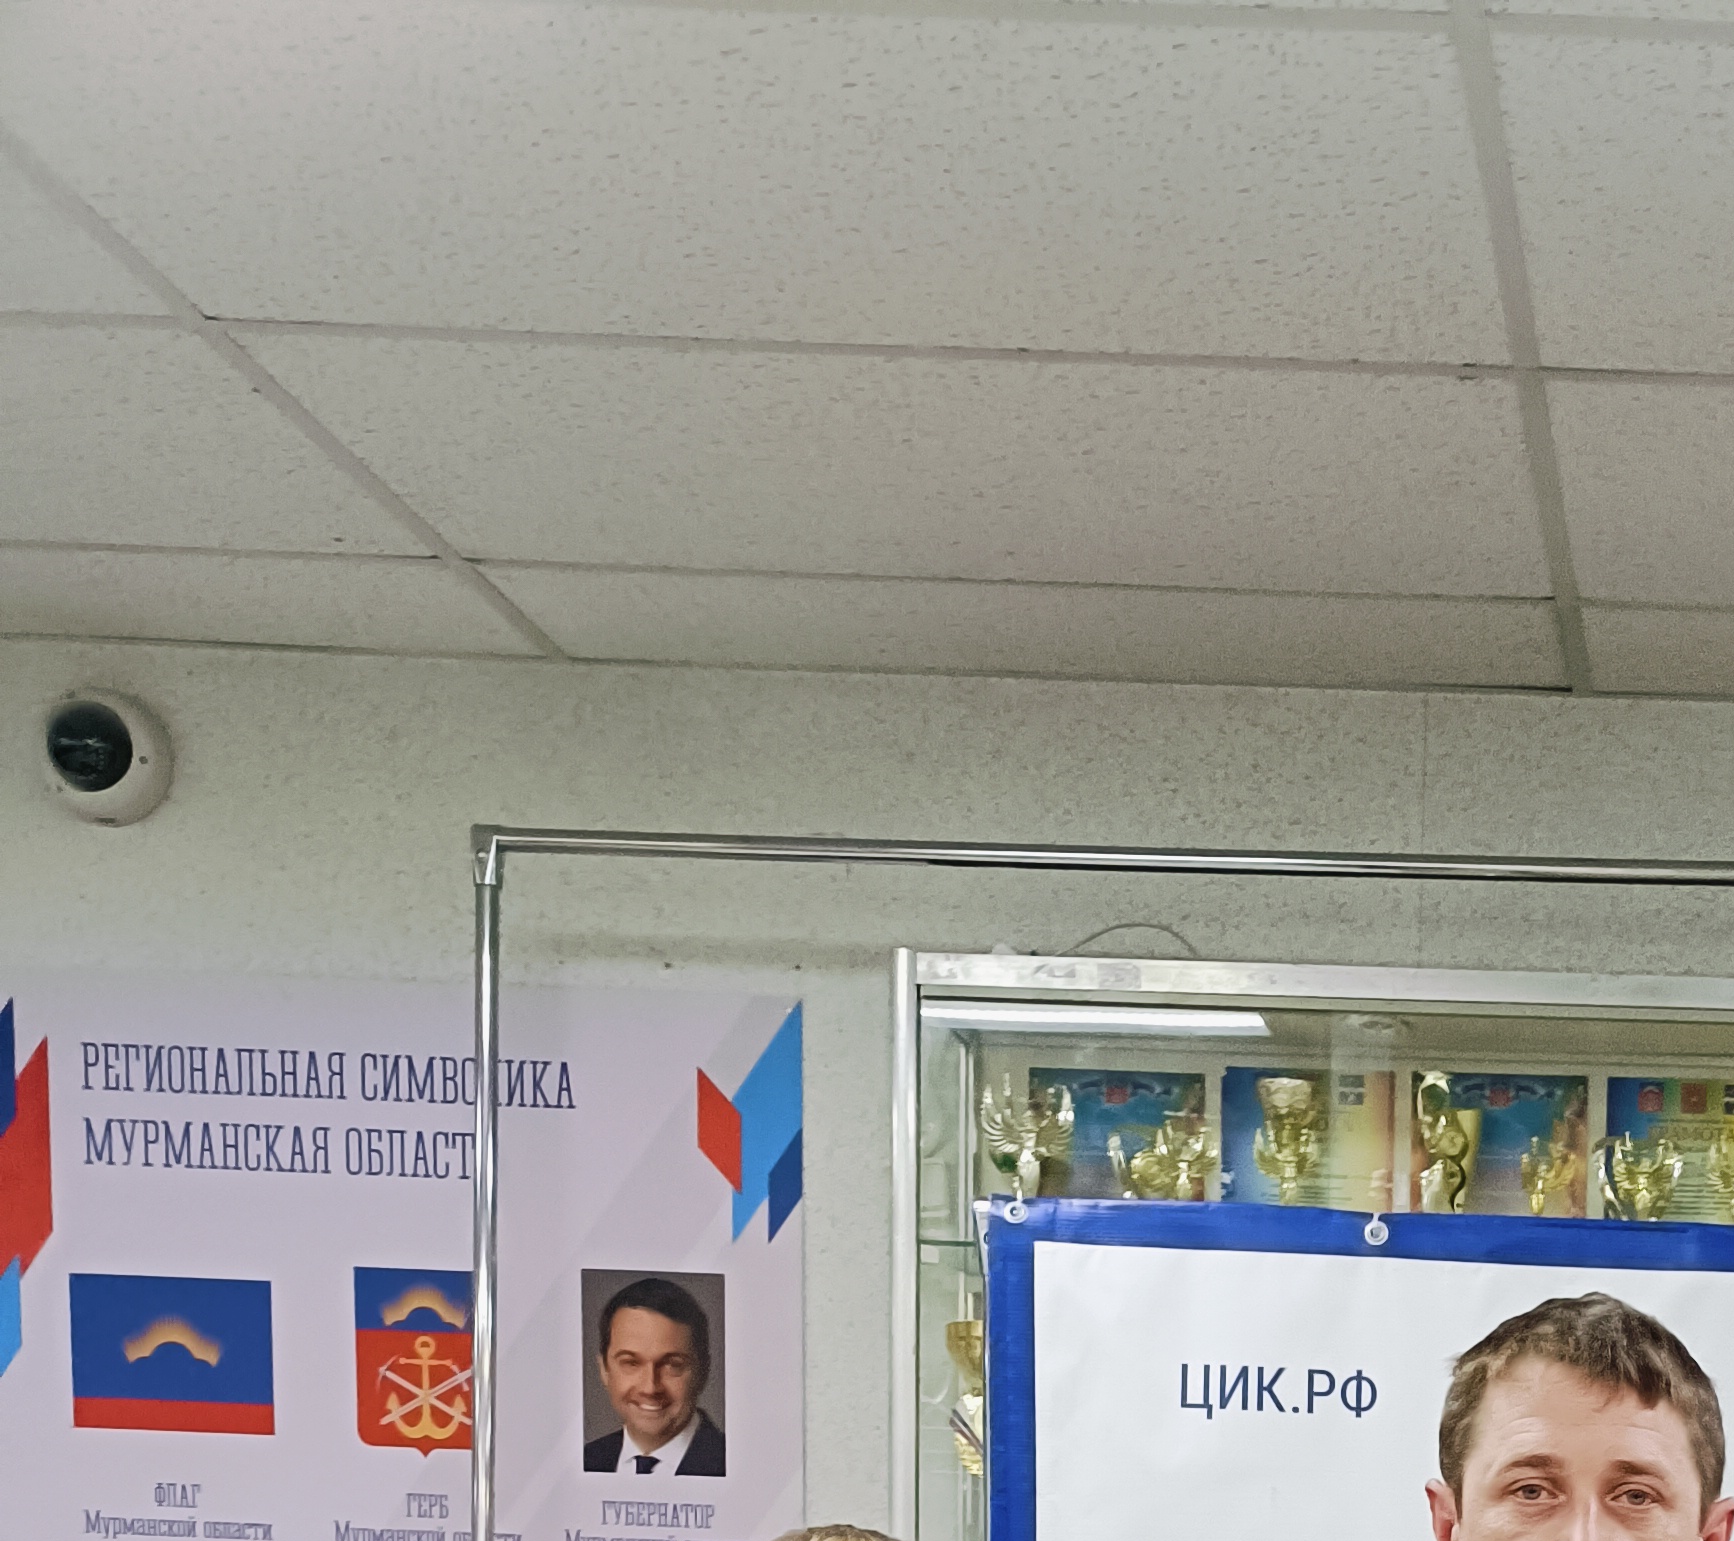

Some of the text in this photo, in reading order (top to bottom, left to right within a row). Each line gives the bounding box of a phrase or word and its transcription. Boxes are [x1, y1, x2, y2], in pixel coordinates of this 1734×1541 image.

[80, 1041, 576, 1109] РЕГИОНАЛЬНАЯ СИМВОИКА
[83, 1116, 475, 1180] МУРМАНСКАЯ ОБЛАСТ
[1180, 1363, 1378, 1420] ЦИК.РФ
[84, 1509, 197, 1540] Мурманской
[406, 1493, 449, 1519] ГЕРБ
[601, 1500, 715, 1529] ГУБЕРНАТОР
